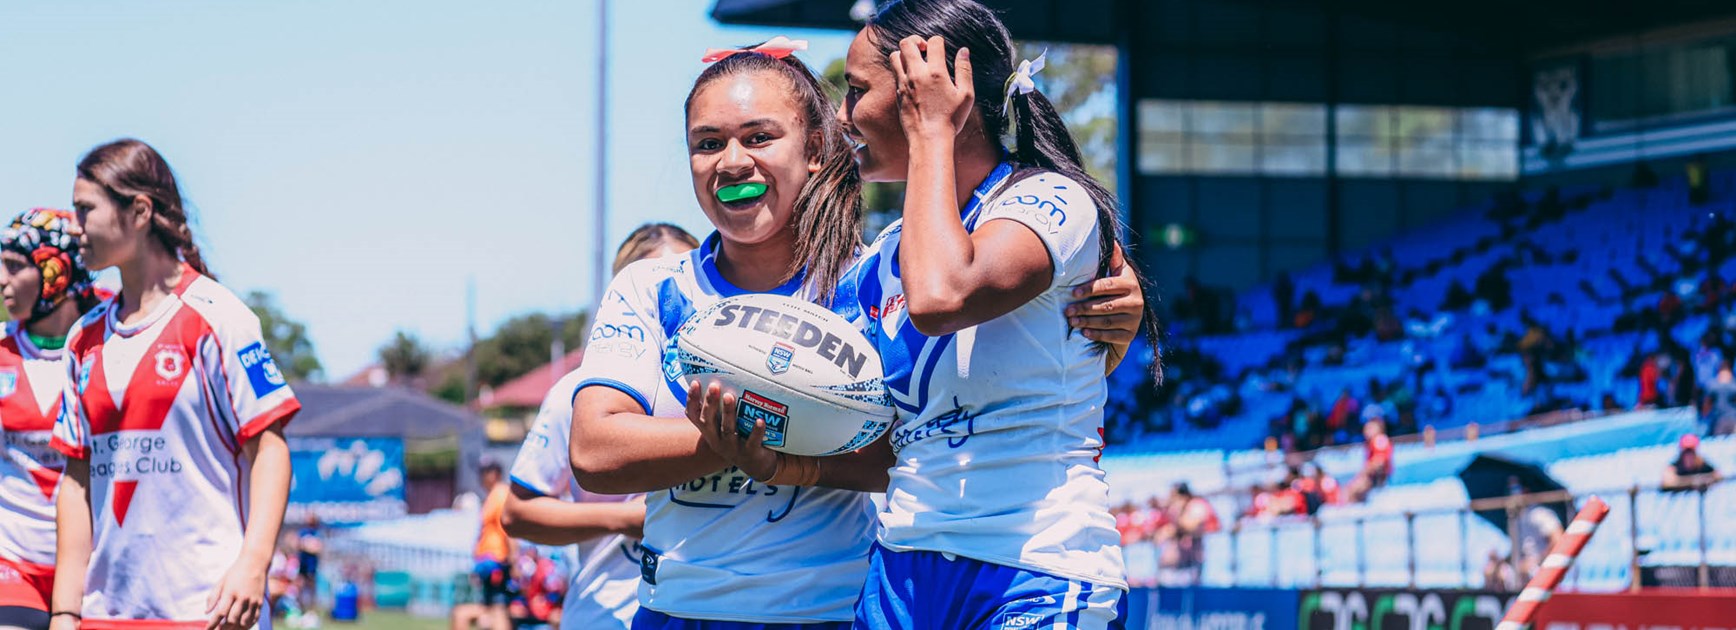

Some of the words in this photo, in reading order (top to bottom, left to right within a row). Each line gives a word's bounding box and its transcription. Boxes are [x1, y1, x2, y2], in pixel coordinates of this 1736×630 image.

[713, 304, 867, 379] STEEDEN
[773, 347, 791, 358] NSW
[743, 404, 781, 427] NSW
[92, 439, 104, 454] t.
[136, 456, 182, 473] Club
[1005, 615, 1041, 627] NSW
